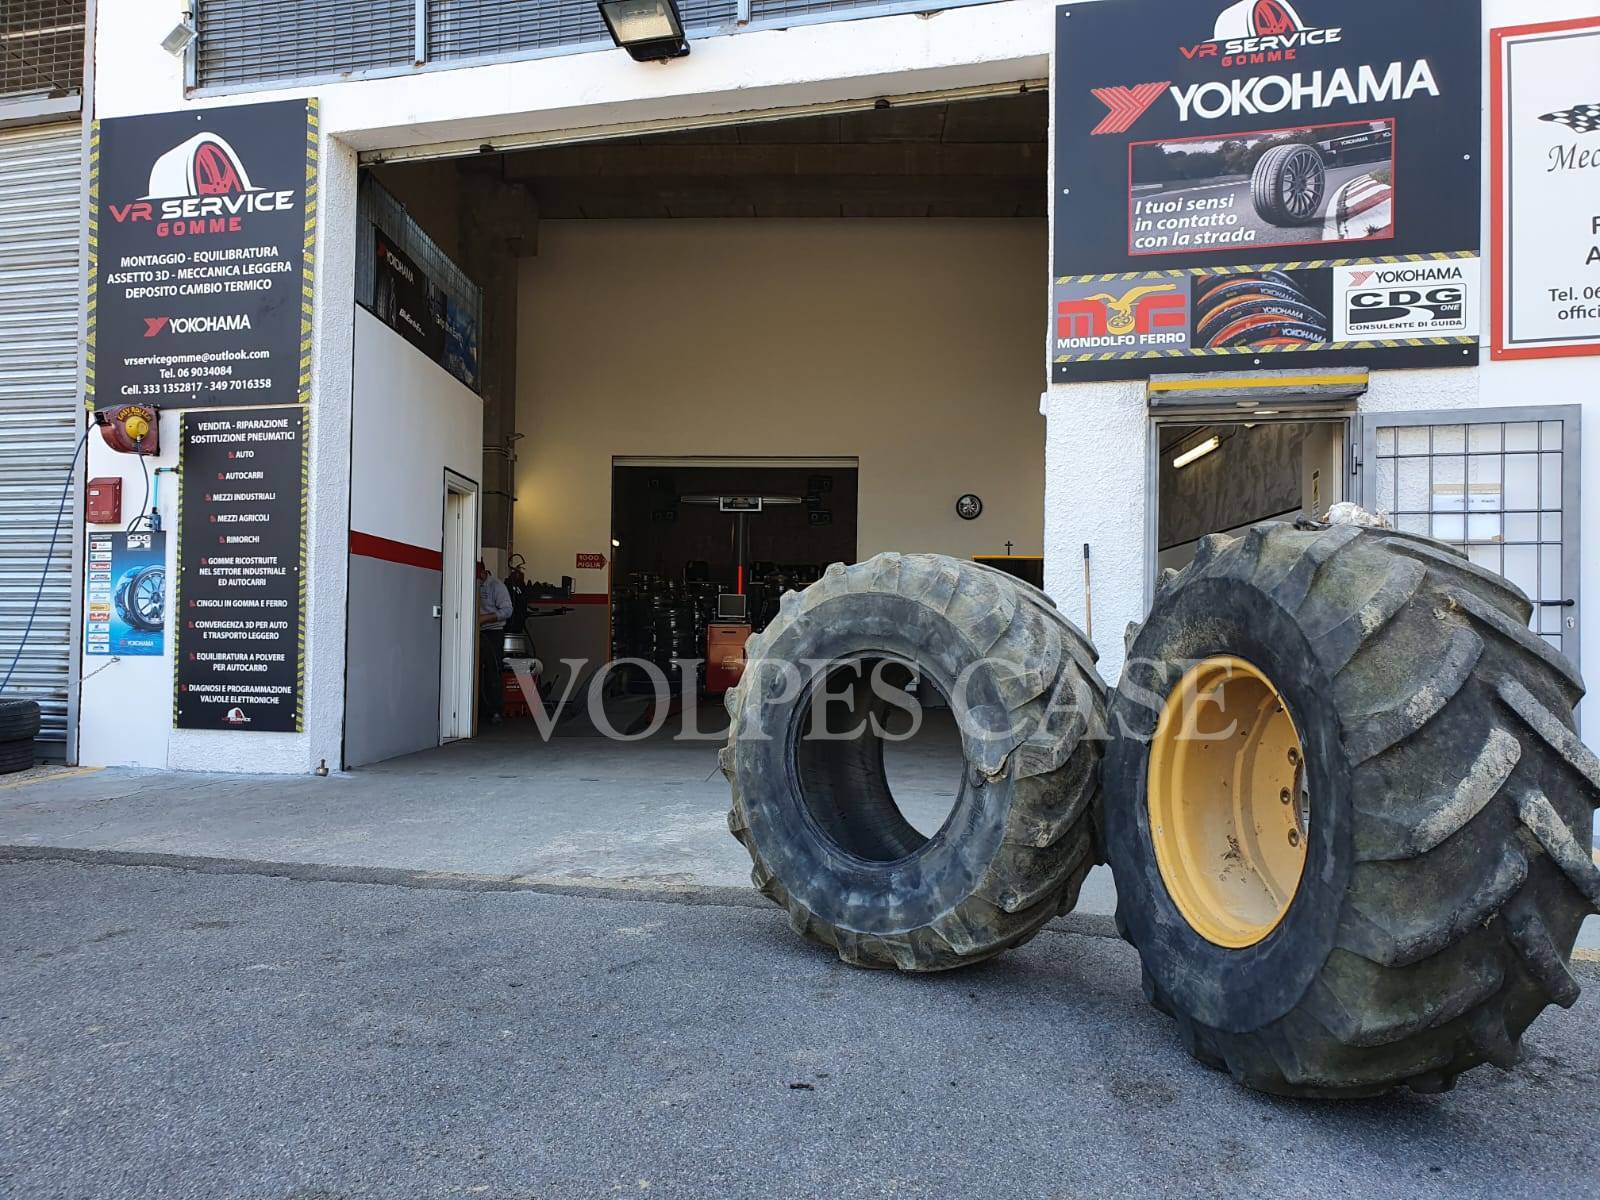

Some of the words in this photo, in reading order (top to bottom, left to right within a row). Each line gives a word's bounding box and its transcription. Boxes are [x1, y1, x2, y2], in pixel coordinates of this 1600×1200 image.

[1179, 43, 1218, 60] VR
[1224, 27, 1343, 56] SERVICE
[1221, 48, 1297, 68] GOMME
[1168, 58, 1441, 122] YOKOHAMA
[108, 202, 153, 223] VR
[160, 190, 295, 220] SERVICE
[1144, 197, 1183, 213] tuoi
[1186, 193, 1235, 211] sensi
[155, 216, 243, 237] GOMME
[1134, 217, 1152, 232] in
[1156, 213, 1238, 230] contatto
[1134, 236, 1168, 249] con
[1172, 231, 1190, 246] la
[1193, 226, 1256, 245] strada
[120, 252, 186, 268] MONTAGGIO
[193, 246, 279, 264] EQUILIBRATURA
[106, 271, 153, 285] ASSETTO
[155, 270, 170, 281] 3D
[177, 265, 241, 280] MECCANICA
[242, 261, 292, 276] LEGGERA
[1374, 266, 1463, 284] YOKOHAMA
[125, 285, 177, 299] DEPOSITO
[179, 282, 222, 295] CAMBIO
[224, 278, 272, 293] TERMICO
[1548, 286, 1578, 302] Tel.
[1350, 287, 1463, 308] CDG
[1263, 307, 1303, 319] YOKOHAMA
[1440, 303, 1460, 312] ONE
[169, 314, 251, 333] YOKOHAMA
[1349, 321, 1415, 331] CONSULENTE
[1417, 320, 1428, 328] DI
[1431, 319, 1463, 327] GUIDA
[1057, 334, 1136, 349] MONDOLFO
[1139, 332, 1186, 346] FERRO
[1281, 328, 1327, 343] YOKOHAMA
[123, 349, 270, 367] vrservicegomme@outlook.com
[160, 368, 176, 379] Tel.
[177, 367, 189, 378] 06
[190, 366, 232, 377] 9034084
[121, 384, 142, 395] Cell.
[143, 383, 160, 394] 333
[162, 381, 203, 393] 1352817
[210, 380, 228, 391] 349
[229, 378, 272, 390] 7016358
[198, 421, 231, 431] VENDITA
[236, 419, 289, 430] RIPARAZIONE
[191, 433, 247, 444] SOSTITUZIONE
[247, 431, 295, 441] PNEUMATICI
[225, 471, 264, 480] AUTOCARRI
[234, 492, 276, 501] INDUSTRIALI
[238, 514, 270, 522] AGRICOLI
[226, 536, 260, 544] RIMORCHI
[207, 557, 234, 565] GOMME
[235, 557, 278, 565] RICOSTRUITE
[242, 567, 286, 575] INDUSTRIALE
[218, 578, 228, 586] ED
[228, 578, 267, 586] AUTOCARRI
[265, 600, 288, 608] FERRO
[195, 621, 244, 629] CONVERGENZA
[245, 621, 254, 629] 3D
[255, 621, 268, 629] PER
[269, 621, 288, 629] AUTO
[248, 632, 280, 640] LEGGERO
[196, 653, 248, 662] EQUILIBRATURA
[226, 664, 268, 672] AUTOCARRO
[188, 684, 221, 692] DIAGNOSI
[227, 685, 292, 694] PROGRAMMAZIONE
[200, 695, 229, 703] VALVOLE
[230, 695, 280, 704] ELETTRONICHE
